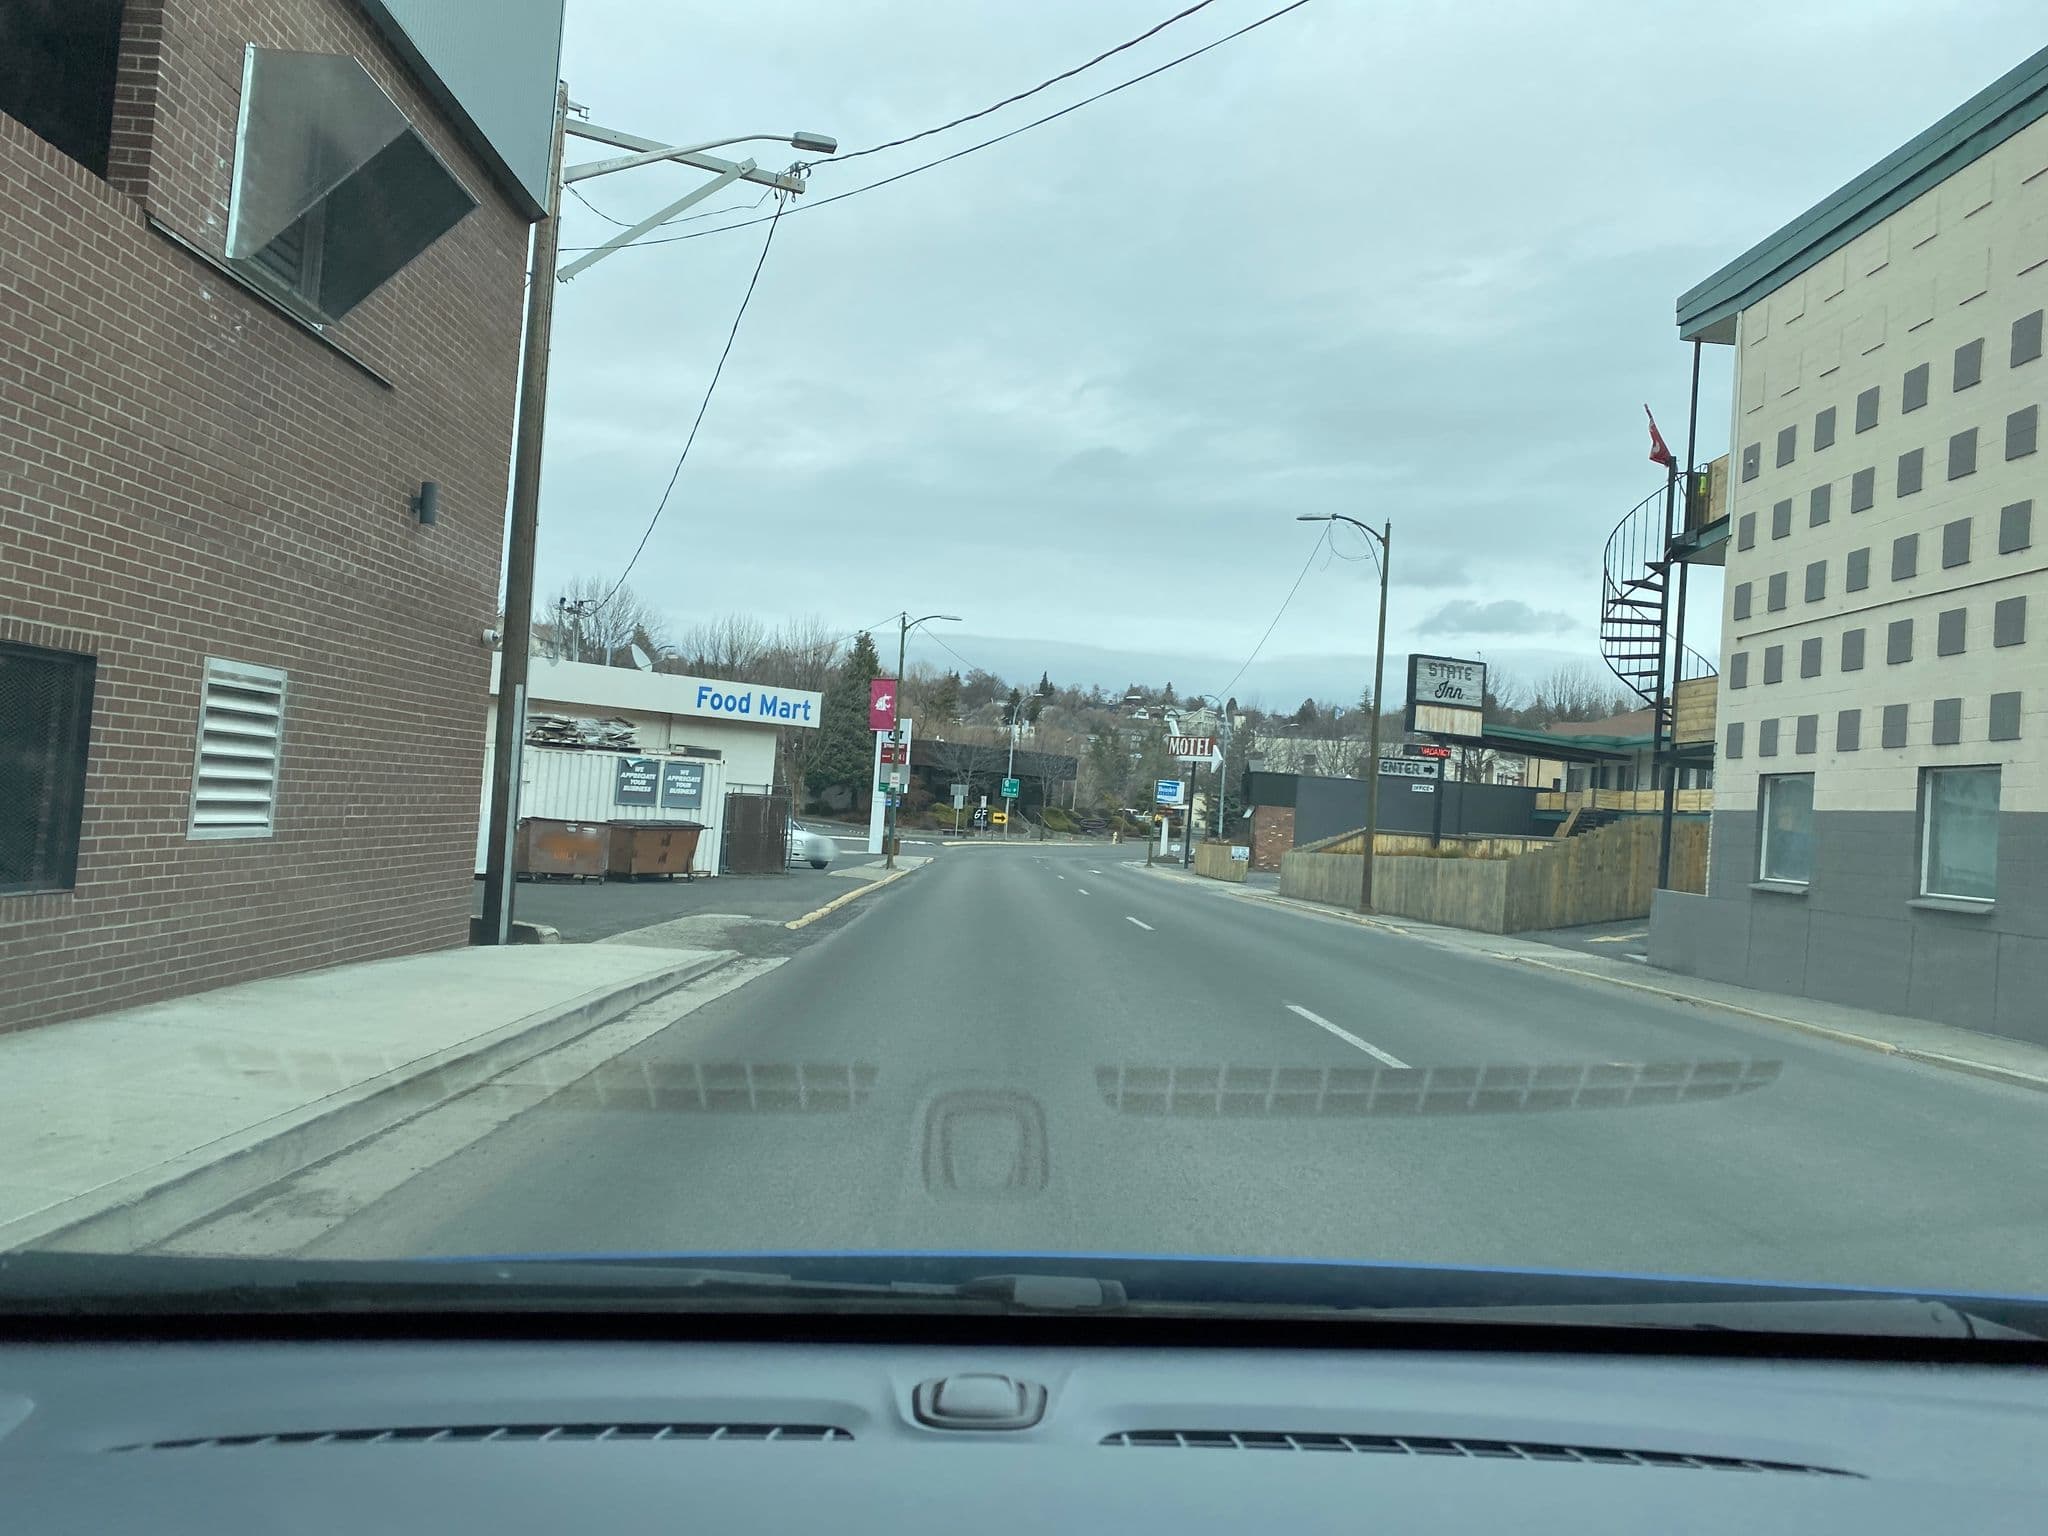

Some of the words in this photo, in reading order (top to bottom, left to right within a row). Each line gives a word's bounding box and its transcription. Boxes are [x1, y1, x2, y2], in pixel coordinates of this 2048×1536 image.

[1428, 662, 1473, 681] STATE
[1434, 680, 1464, 699] Inn
[696, 685, 752, 714] Food
[759, 692, 811, 721] Mart
[1168, 737, 1211, 756] MOTEL
[1420, 746, 1451, 757] VACANCY
[1381, 761, 1420, 775] ENTER
